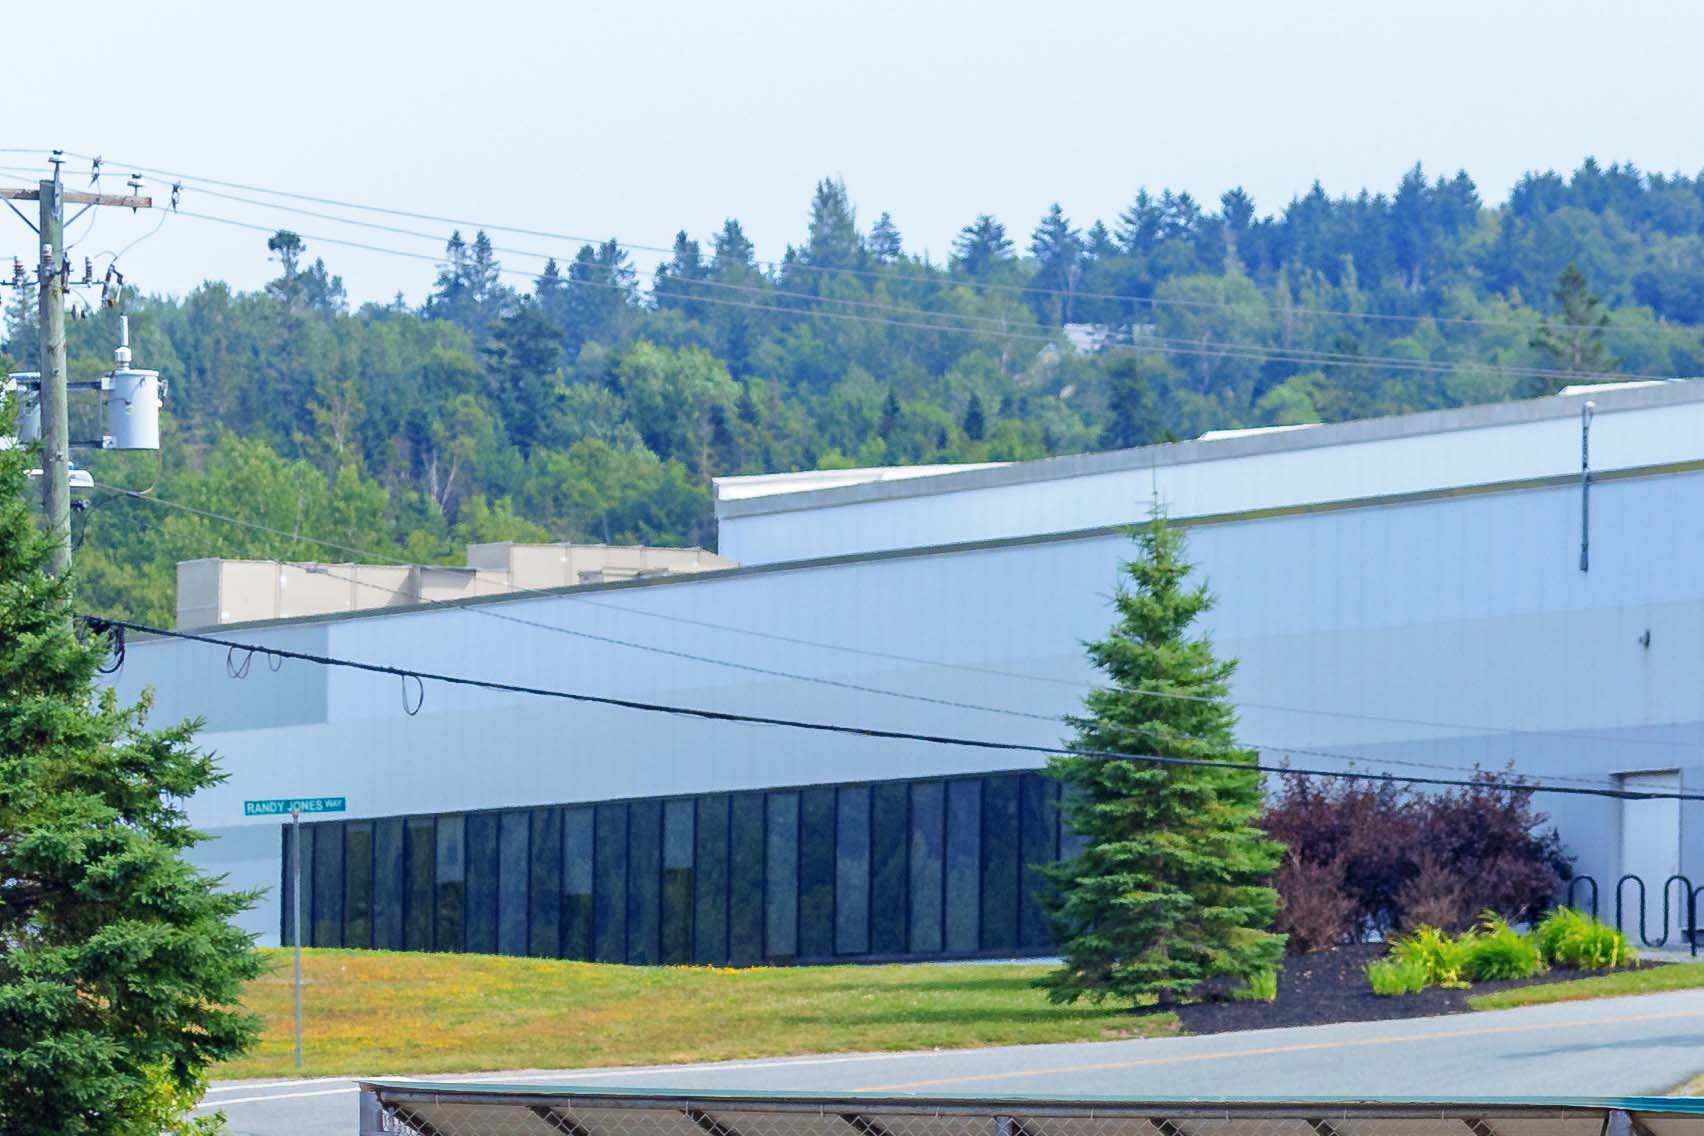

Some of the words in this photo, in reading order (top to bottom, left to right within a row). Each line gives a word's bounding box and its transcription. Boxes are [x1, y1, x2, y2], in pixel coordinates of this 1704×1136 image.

[246, 801, 285, 814] RANDY
[287, 800, 324, 812] JONES
[325, 799, 342, 808] WAY
